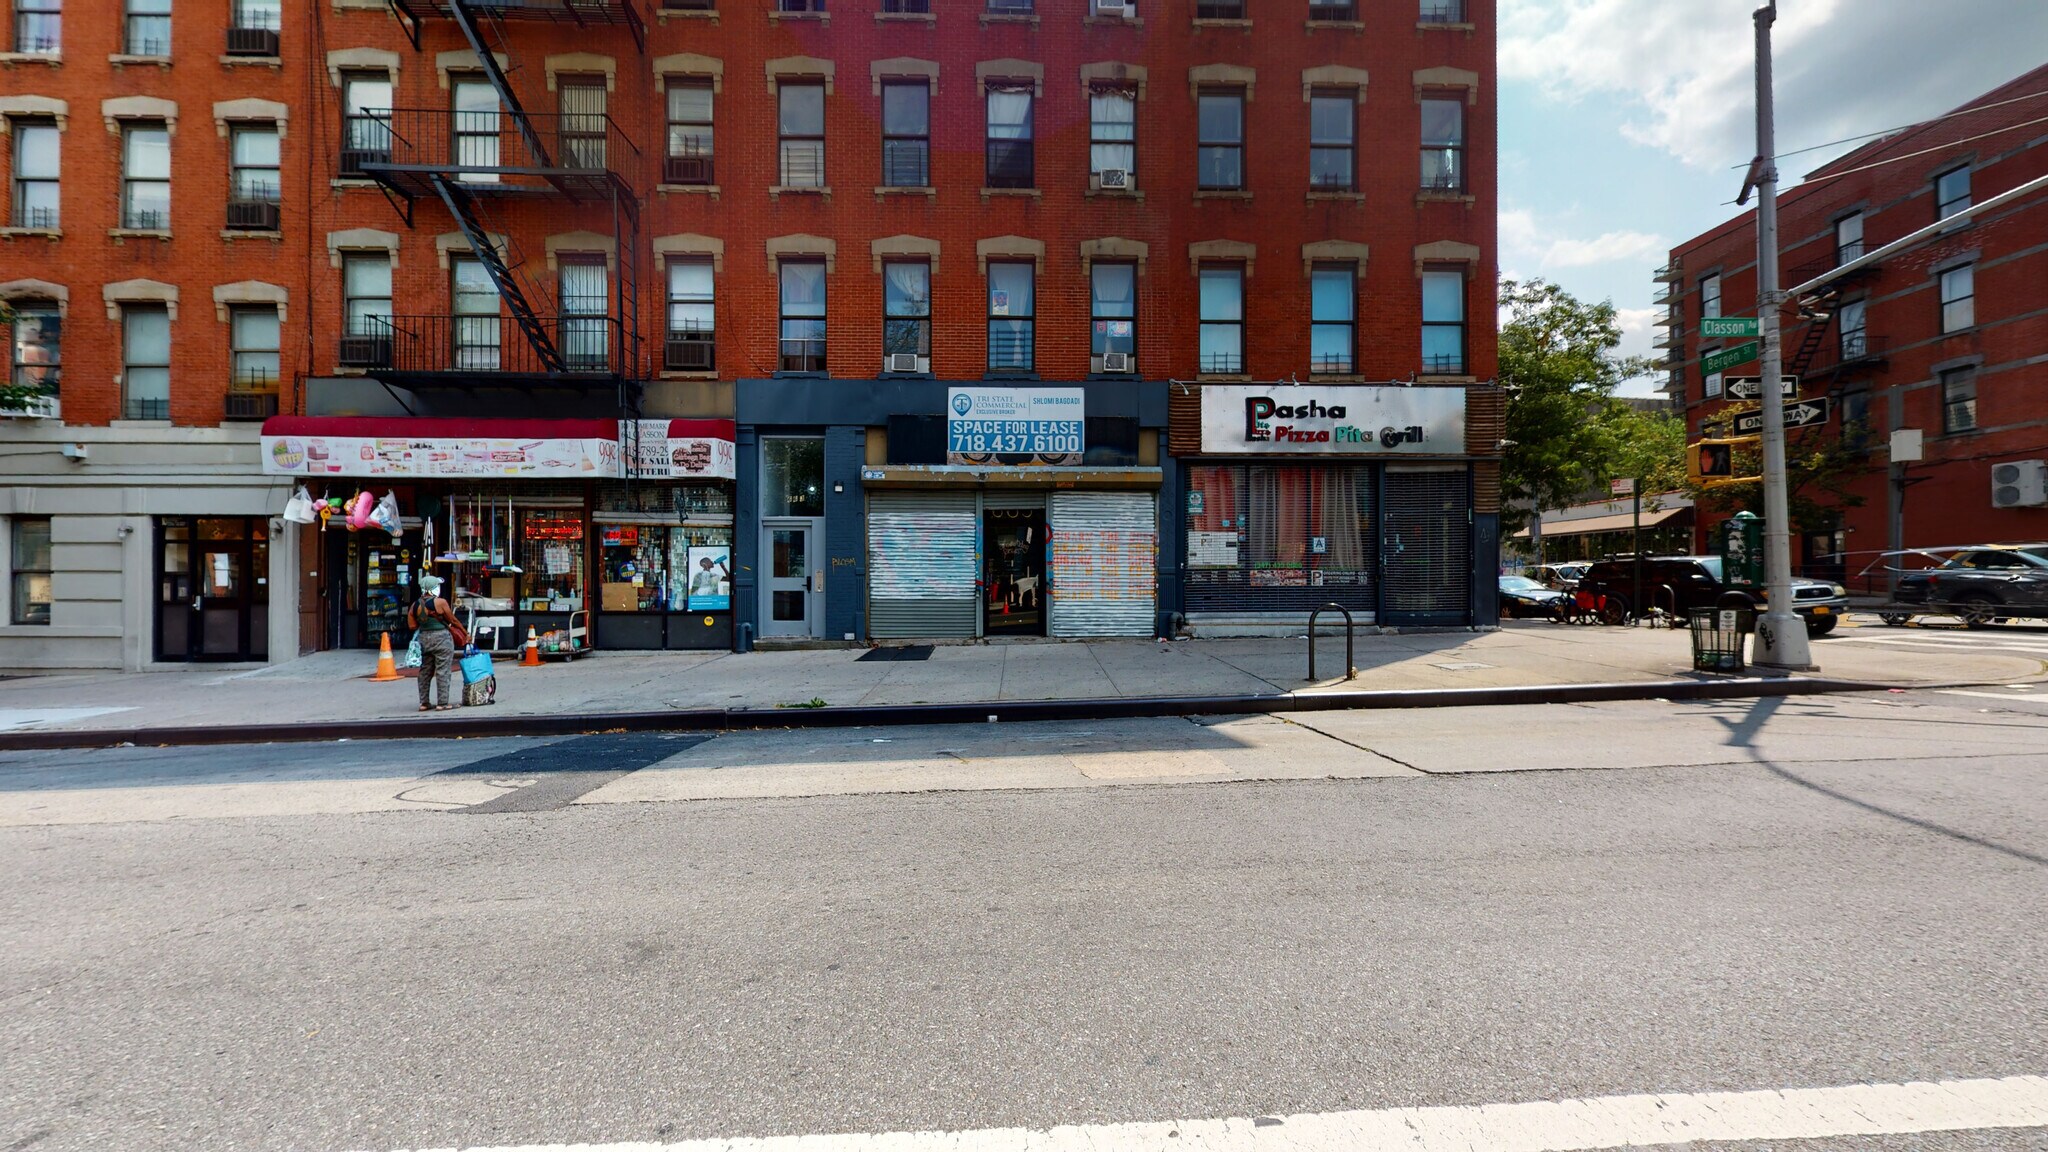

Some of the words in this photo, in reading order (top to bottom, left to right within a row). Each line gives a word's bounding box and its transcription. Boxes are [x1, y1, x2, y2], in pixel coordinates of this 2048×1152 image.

[1704, 320, 1745, 335] Classon
[1707, 352, 1740, 370] Bergen
[1735, 384, 1756, 393] ONE
[1033, 397, 1055, 405] SHLOMI
[1745, 417, 1762, 428] ON
[1783, 408, 1811, 421] WAY
[953, 421, 1002, 434] SPACE
[1005, 421, 1027, 434] FOR
[1030, 421, 1078, 434] LEASE
[953, 435, 1079, 452] 718.437.6100
[1275, 425, 1330, 442] Pizza
[1335, 425, 1374, 443] Pita
[1380, 425, 1423, 448] Grill
[1315, 539, 1323, 548] A
